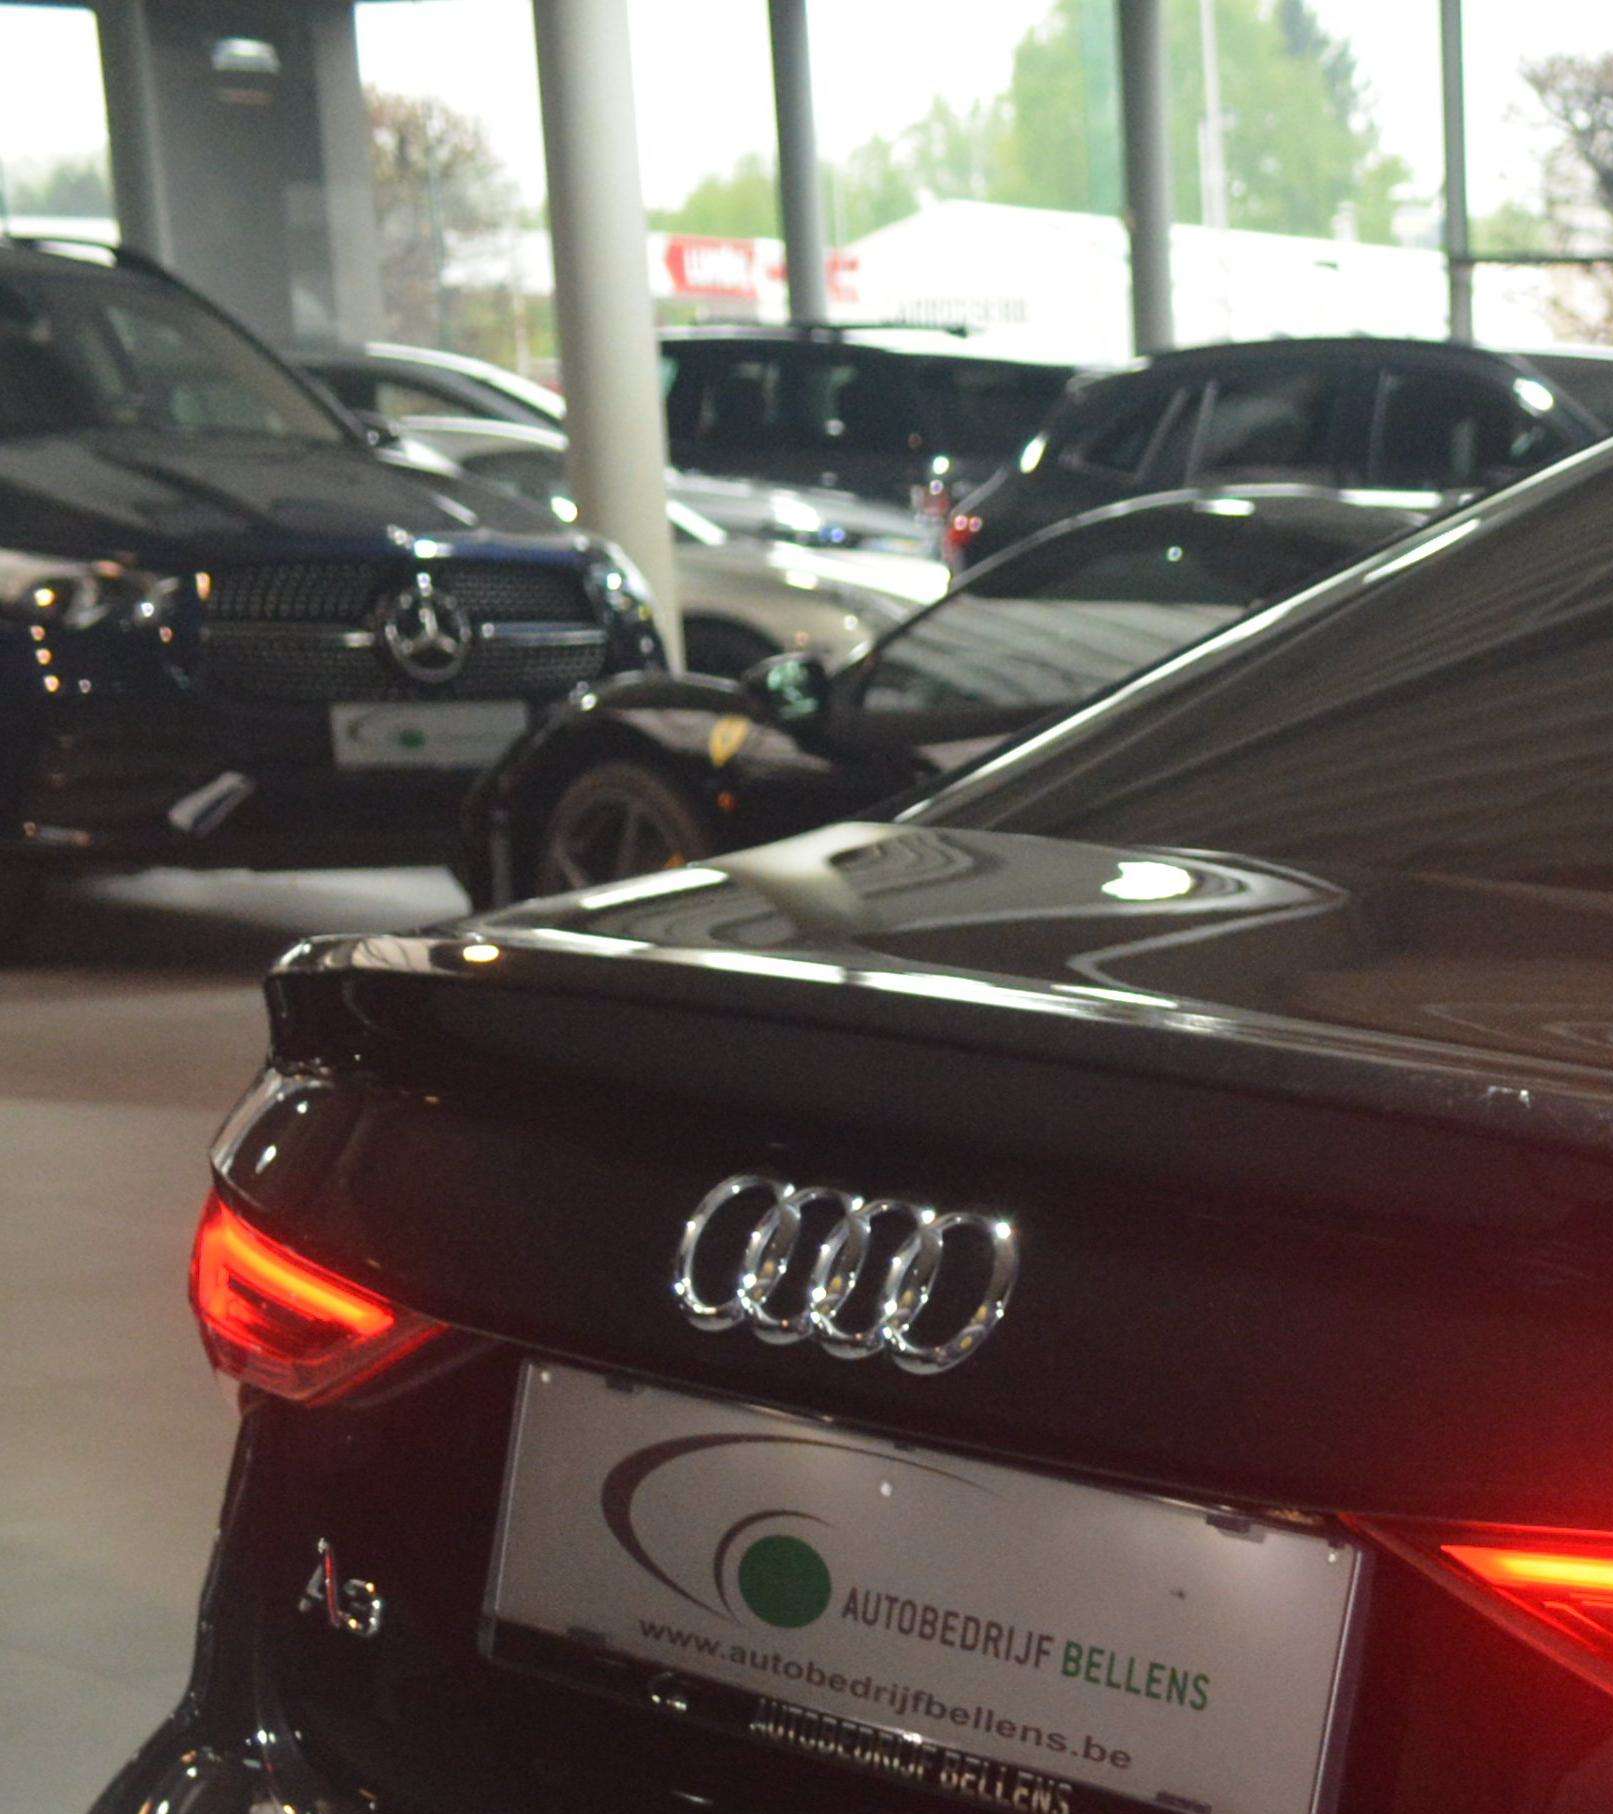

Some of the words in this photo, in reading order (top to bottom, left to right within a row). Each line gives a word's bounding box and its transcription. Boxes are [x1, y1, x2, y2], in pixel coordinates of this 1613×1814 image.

[299, 1537, 381, 1638] A3
[840, 1587, 1055, 1669] AUTOBEDRIJF
[1060, 1639, 1211, 1711] BELLENS
[638, 1618, 1132, 1770] www.autobedrijfbellens.be
